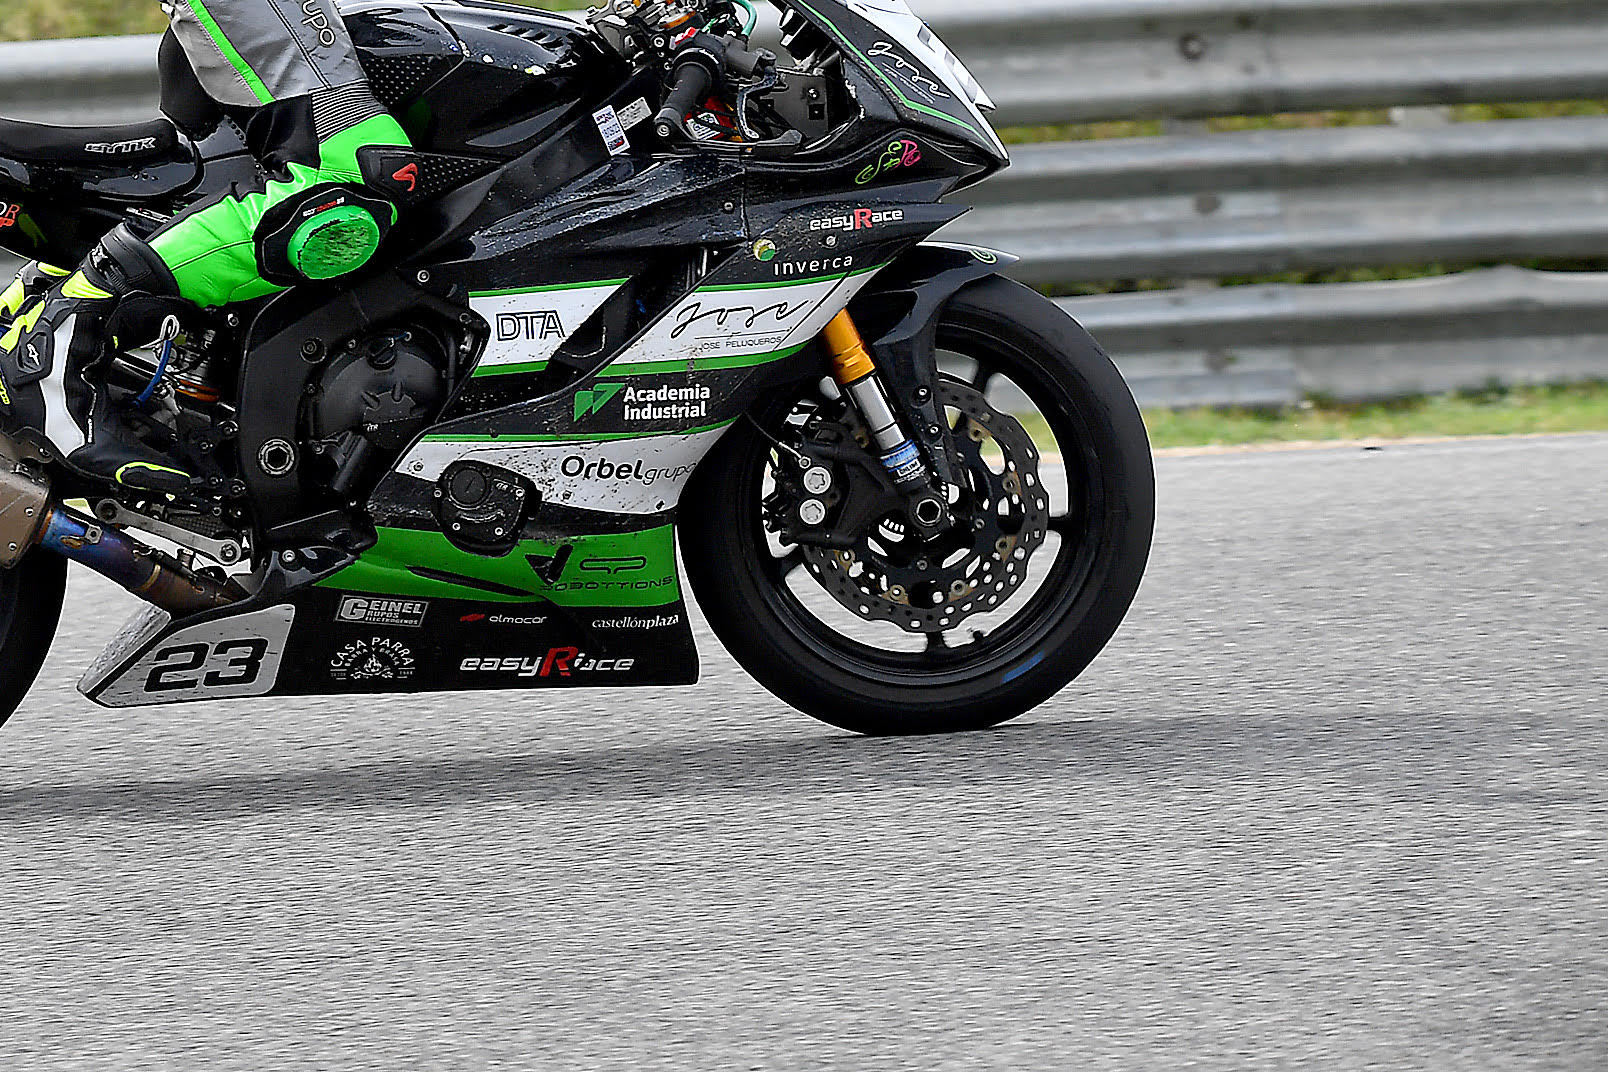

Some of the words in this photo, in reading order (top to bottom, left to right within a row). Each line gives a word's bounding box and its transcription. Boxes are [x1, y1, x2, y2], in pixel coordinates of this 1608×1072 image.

[809, 208, 903, 231] easyRace
[496, 310, 567, 341] DTA
[623, 383, 711, 403] Academia
[623, 401, 707, 420] Industrial
[144, 637, 269, 693] 23
[330, 639, 367, 667] CASA
[371, 637, 414, 666] PARRA
